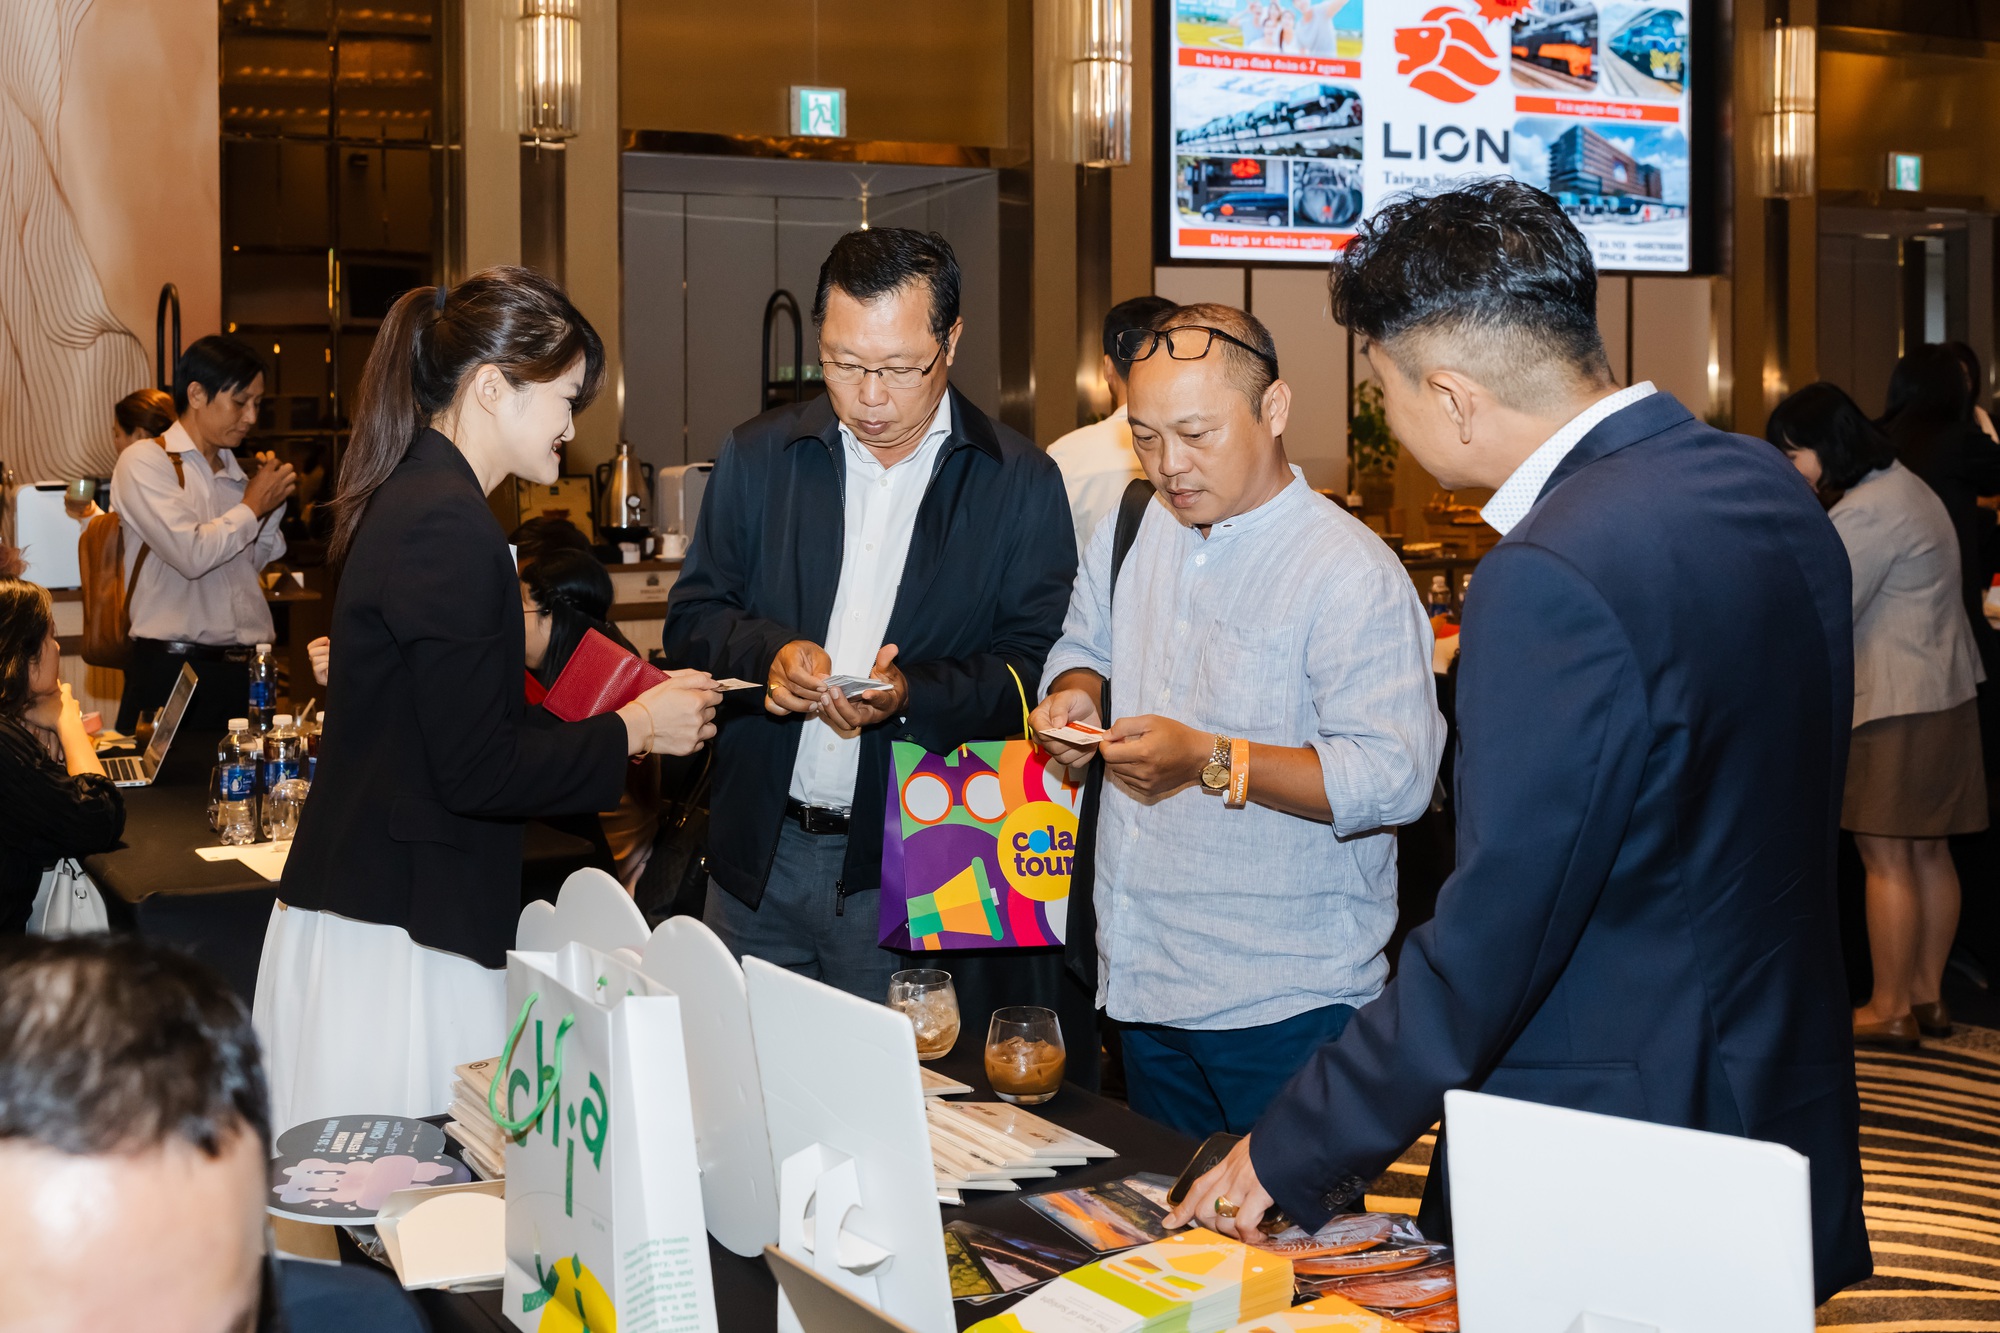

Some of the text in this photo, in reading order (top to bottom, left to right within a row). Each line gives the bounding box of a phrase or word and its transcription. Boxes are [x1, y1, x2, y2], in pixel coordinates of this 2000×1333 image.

[1383, 122, 1510, 164] LION
[1383, 171, 1430, 186] Taiwan
[1235, 772, 1245, 803] TAIWAN
[1012, 825, 1076, 854] cola
[678, 1268, 693, 1276] and
[681, 1290, 696, 1299] and
[671, 1313, 699, 1322] Taiwan
